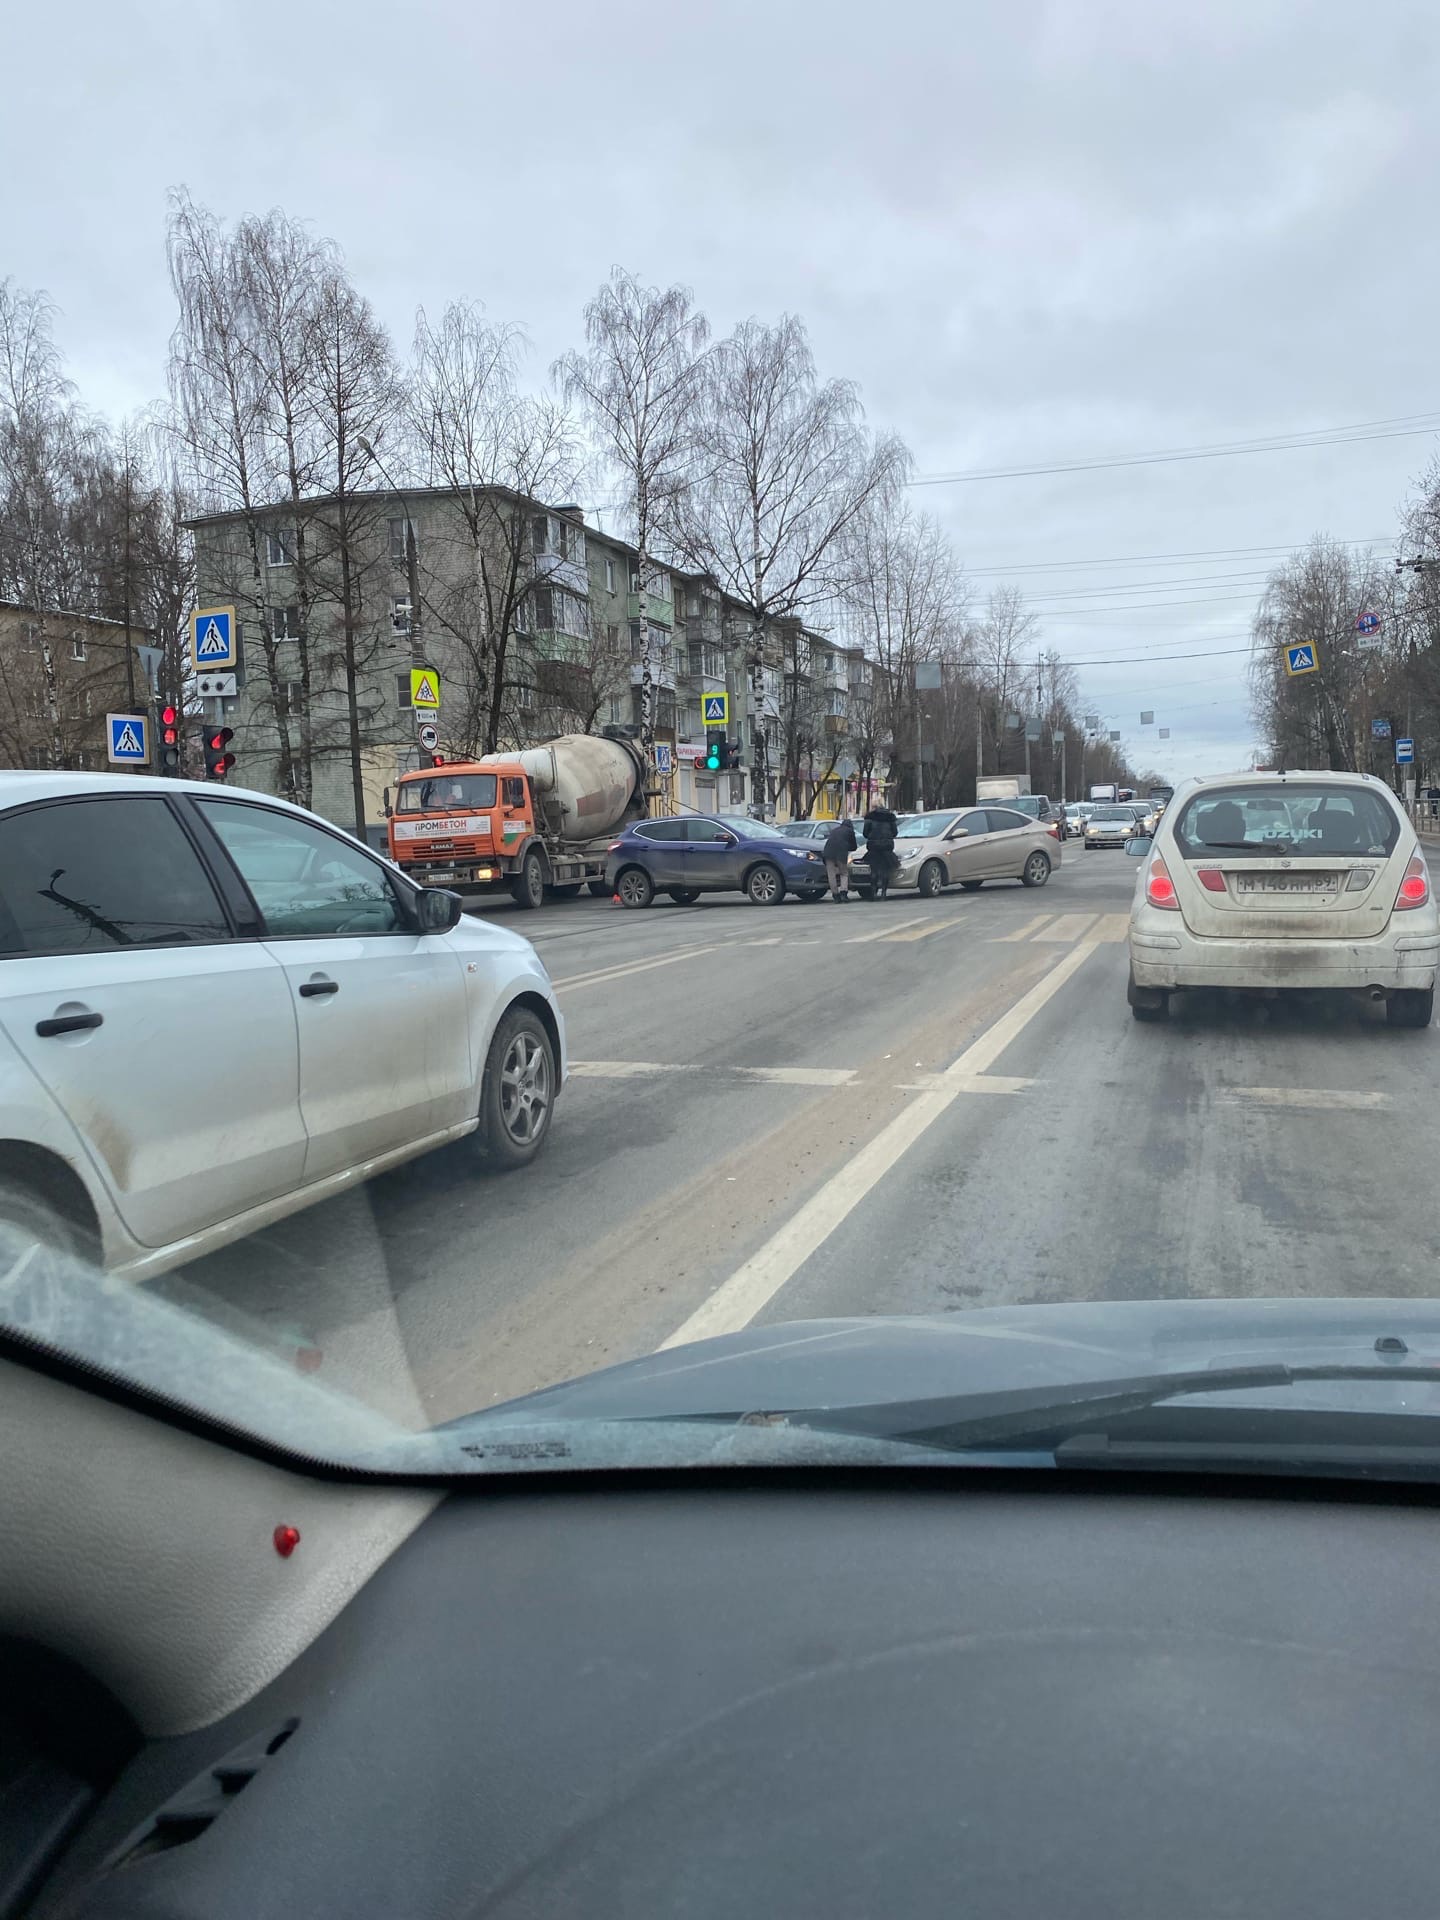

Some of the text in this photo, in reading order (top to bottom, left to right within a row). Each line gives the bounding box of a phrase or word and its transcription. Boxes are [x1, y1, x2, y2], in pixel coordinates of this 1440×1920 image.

[712, 745, 718, 755] 9
[415, 820, 467, 831] ПРОМБЕТОН
[1255, 829, 1322, 839] UZUKI
